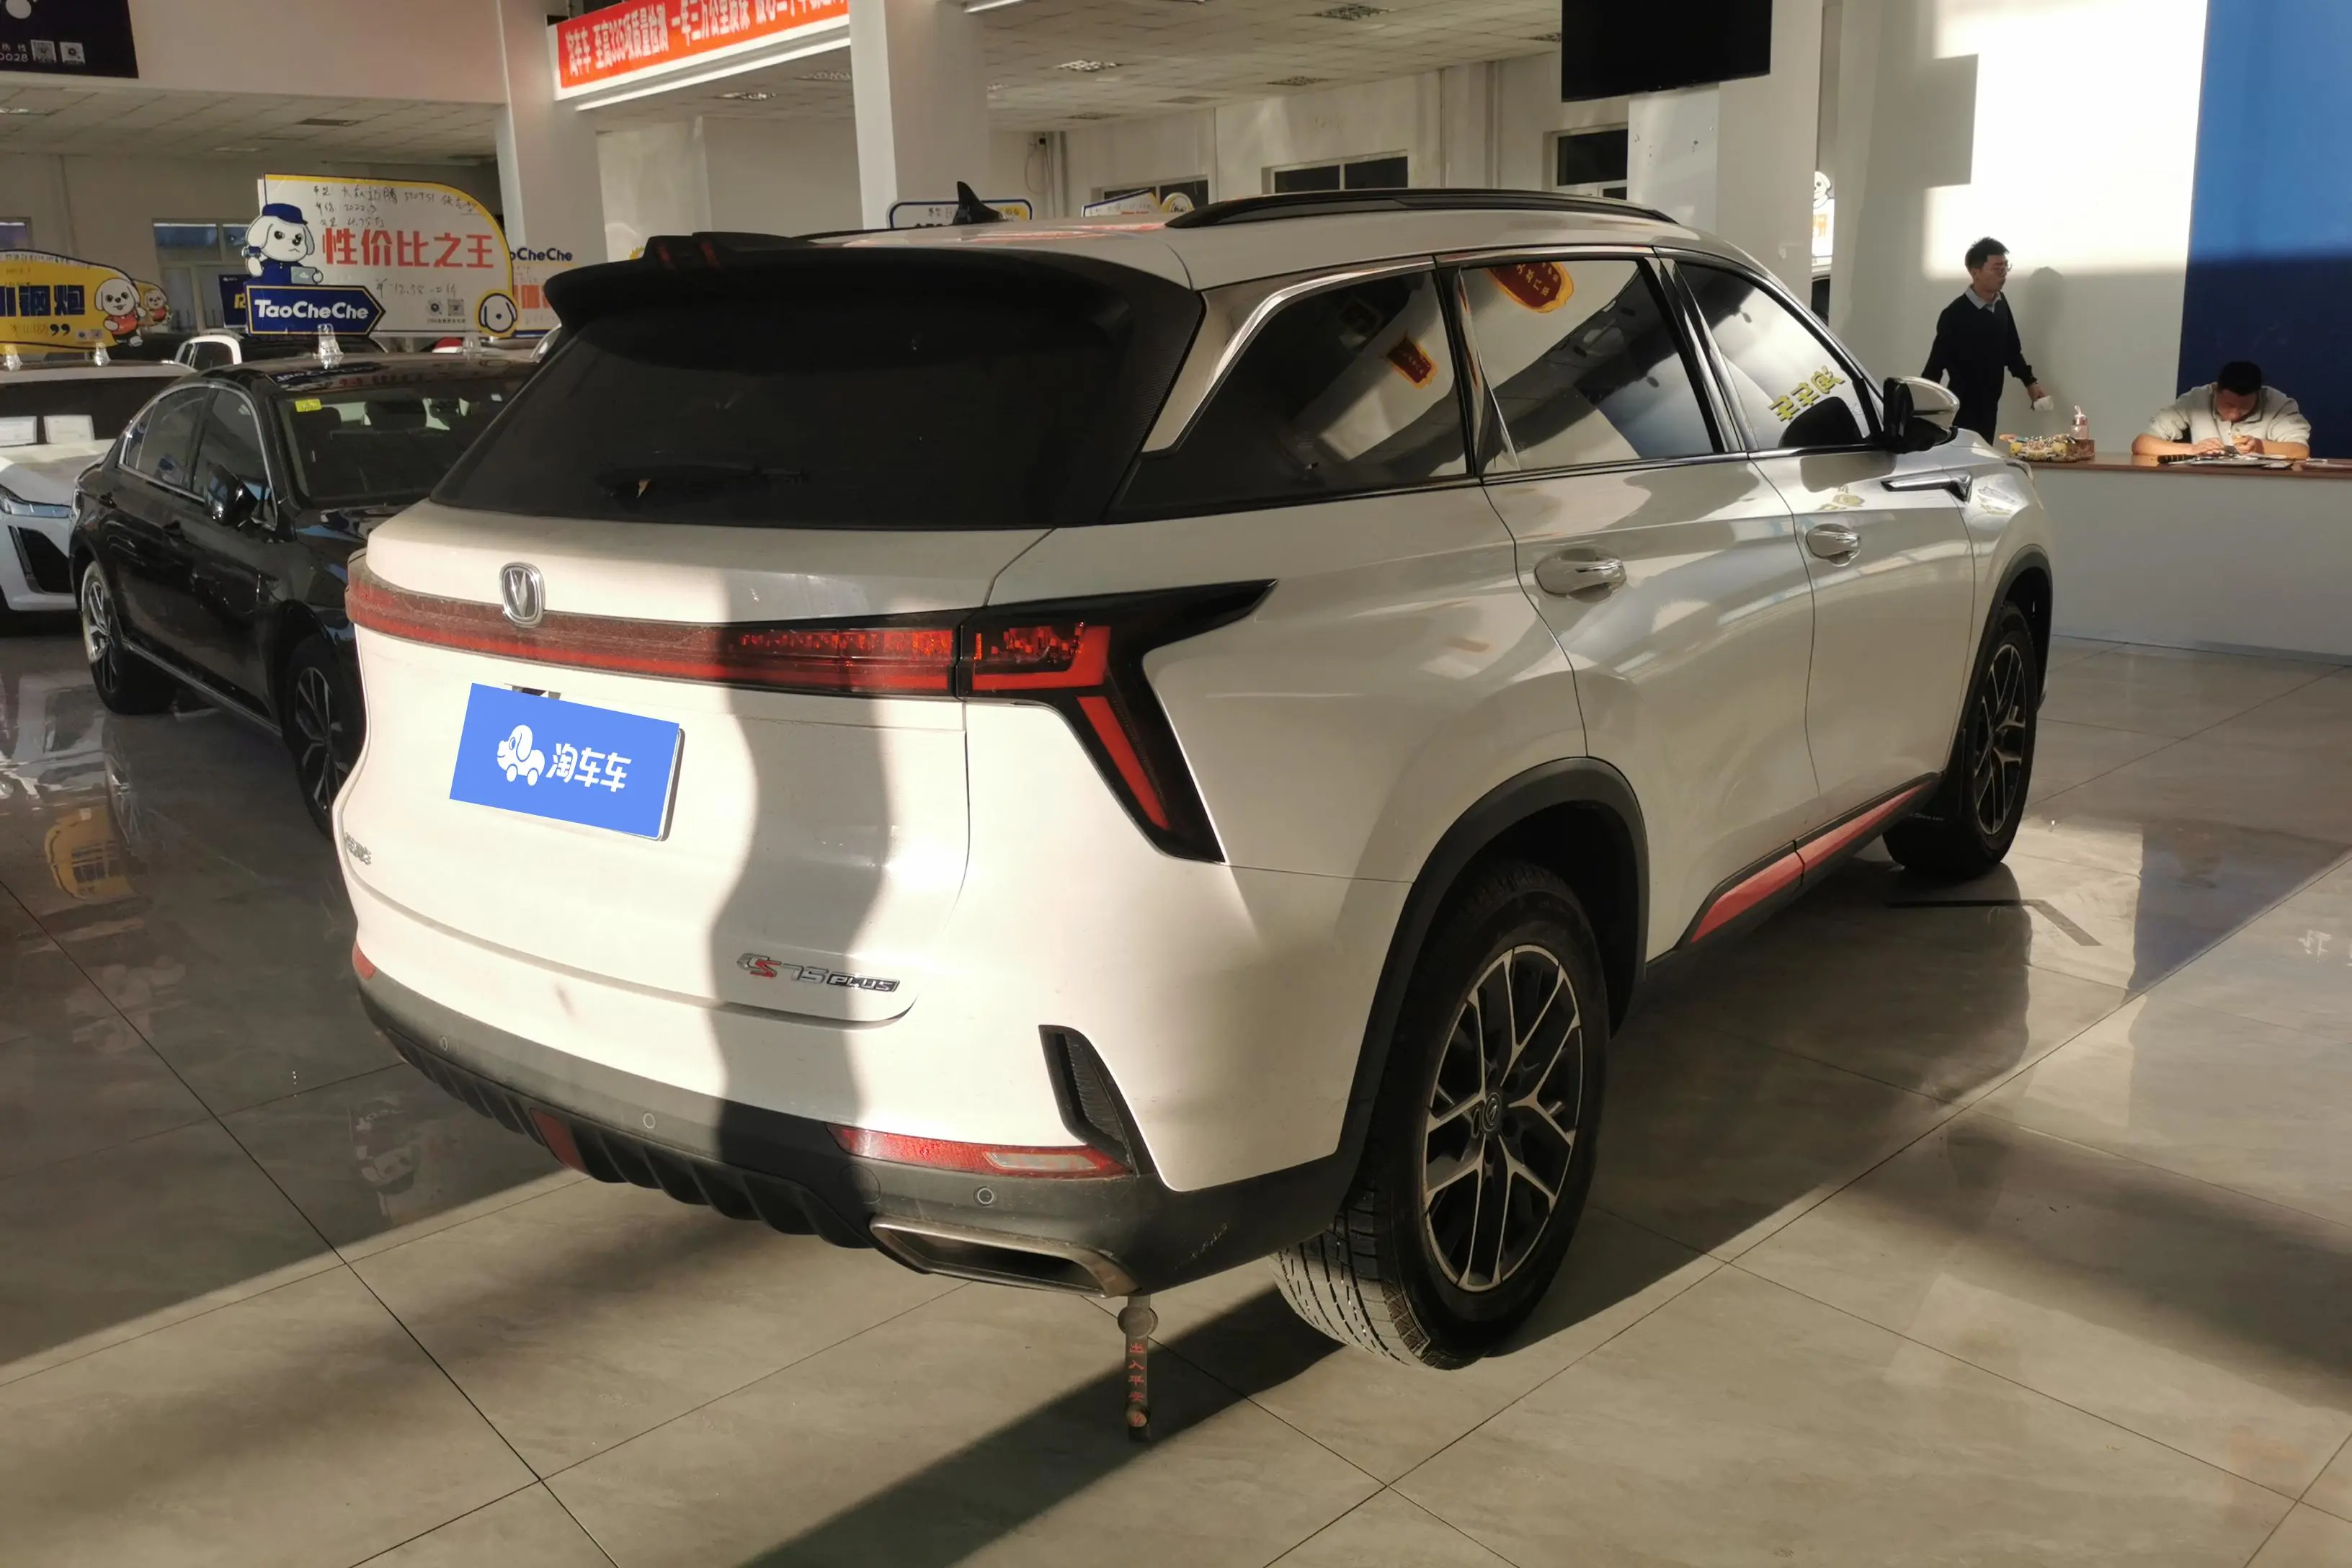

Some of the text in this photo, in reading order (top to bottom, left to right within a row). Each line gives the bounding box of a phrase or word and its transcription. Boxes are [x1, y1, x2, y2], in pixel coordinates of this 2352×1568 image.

[323, 227, 494, 269] 性价比之王
[254, 299, 369, 319] TaoCheChe
